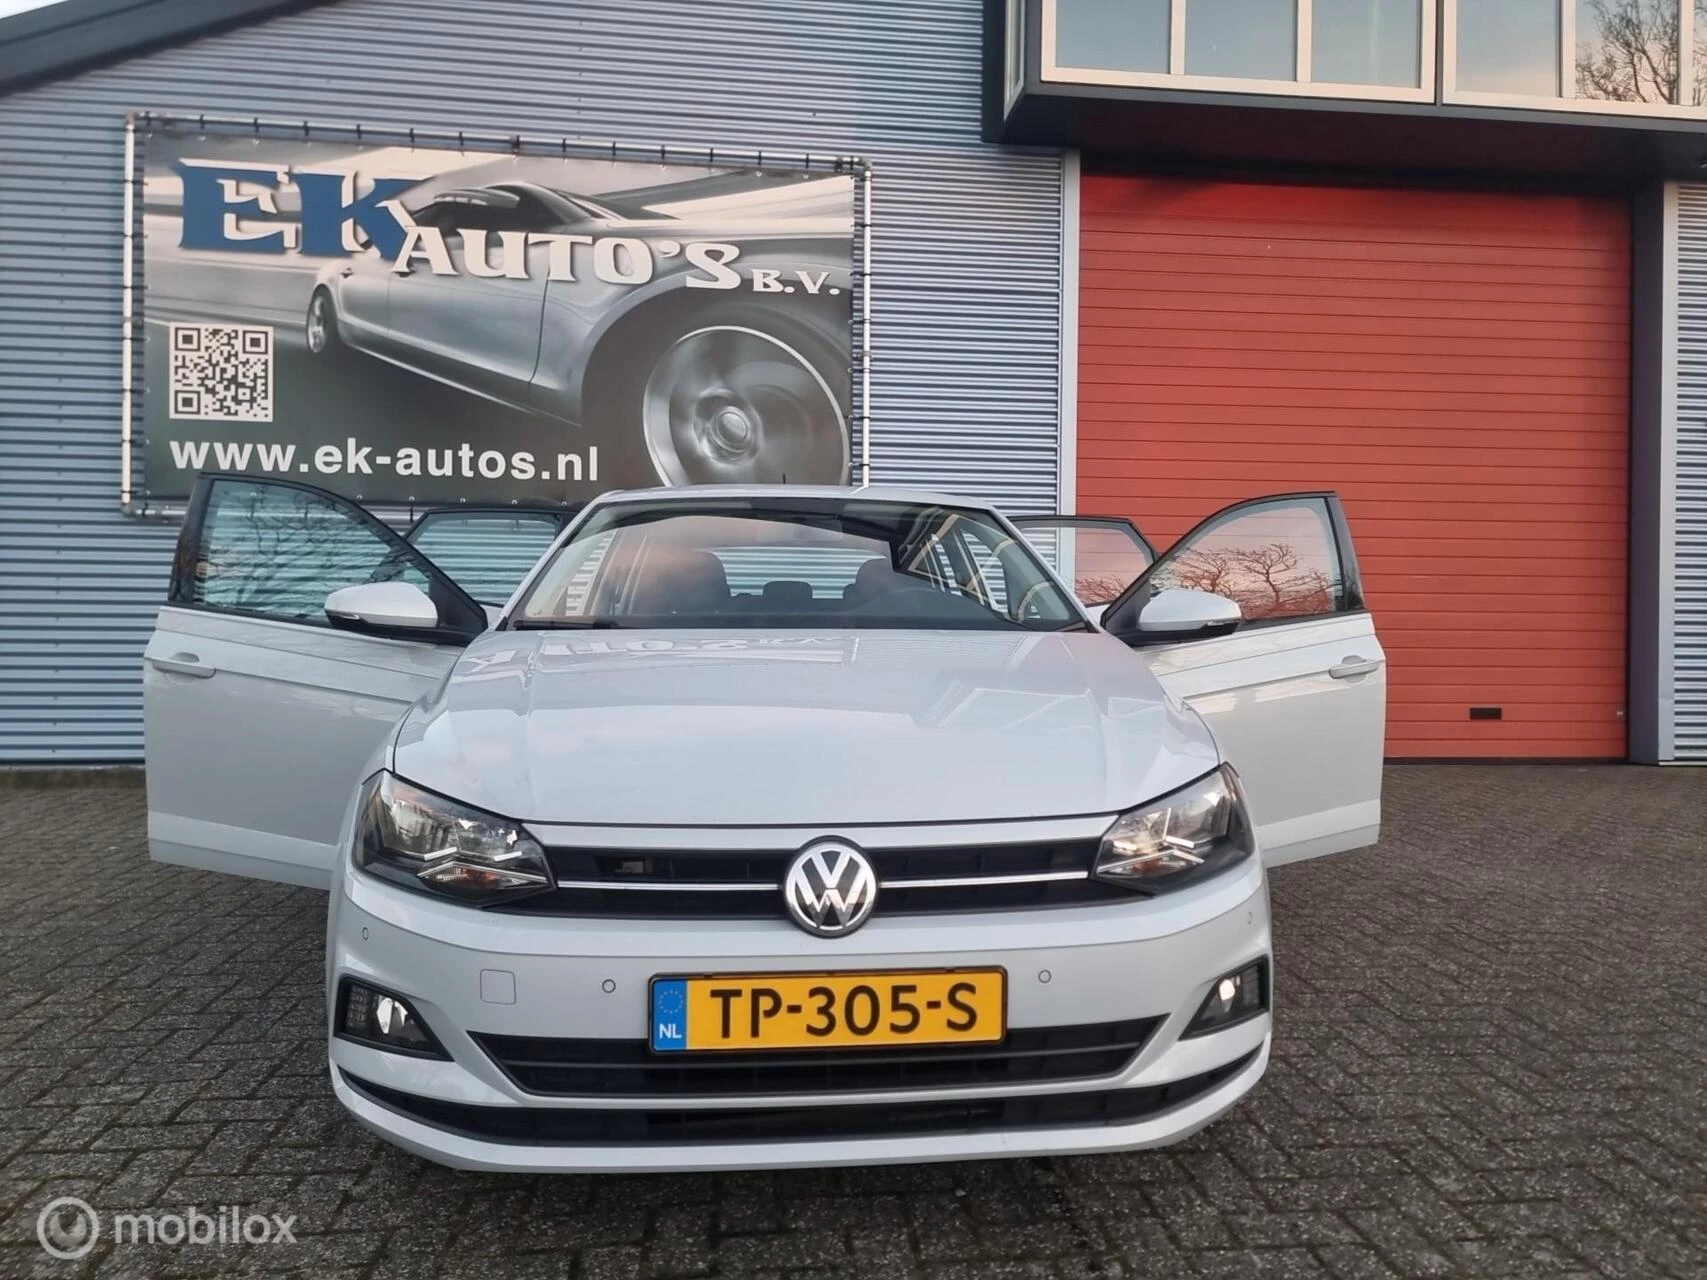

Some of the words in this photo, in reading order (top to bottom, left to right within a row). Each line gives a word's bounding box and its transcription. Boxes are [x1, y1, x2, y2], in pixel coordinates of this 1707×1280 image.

[177, 158, 434, 260] EK
[751, 268, 841, 295] B.V.
[170, 438, 599, 481] www.ek-autos.nl
[659, 1023, 682, 1039] NL
[710, 982, 977, 1039] TP-305-S
